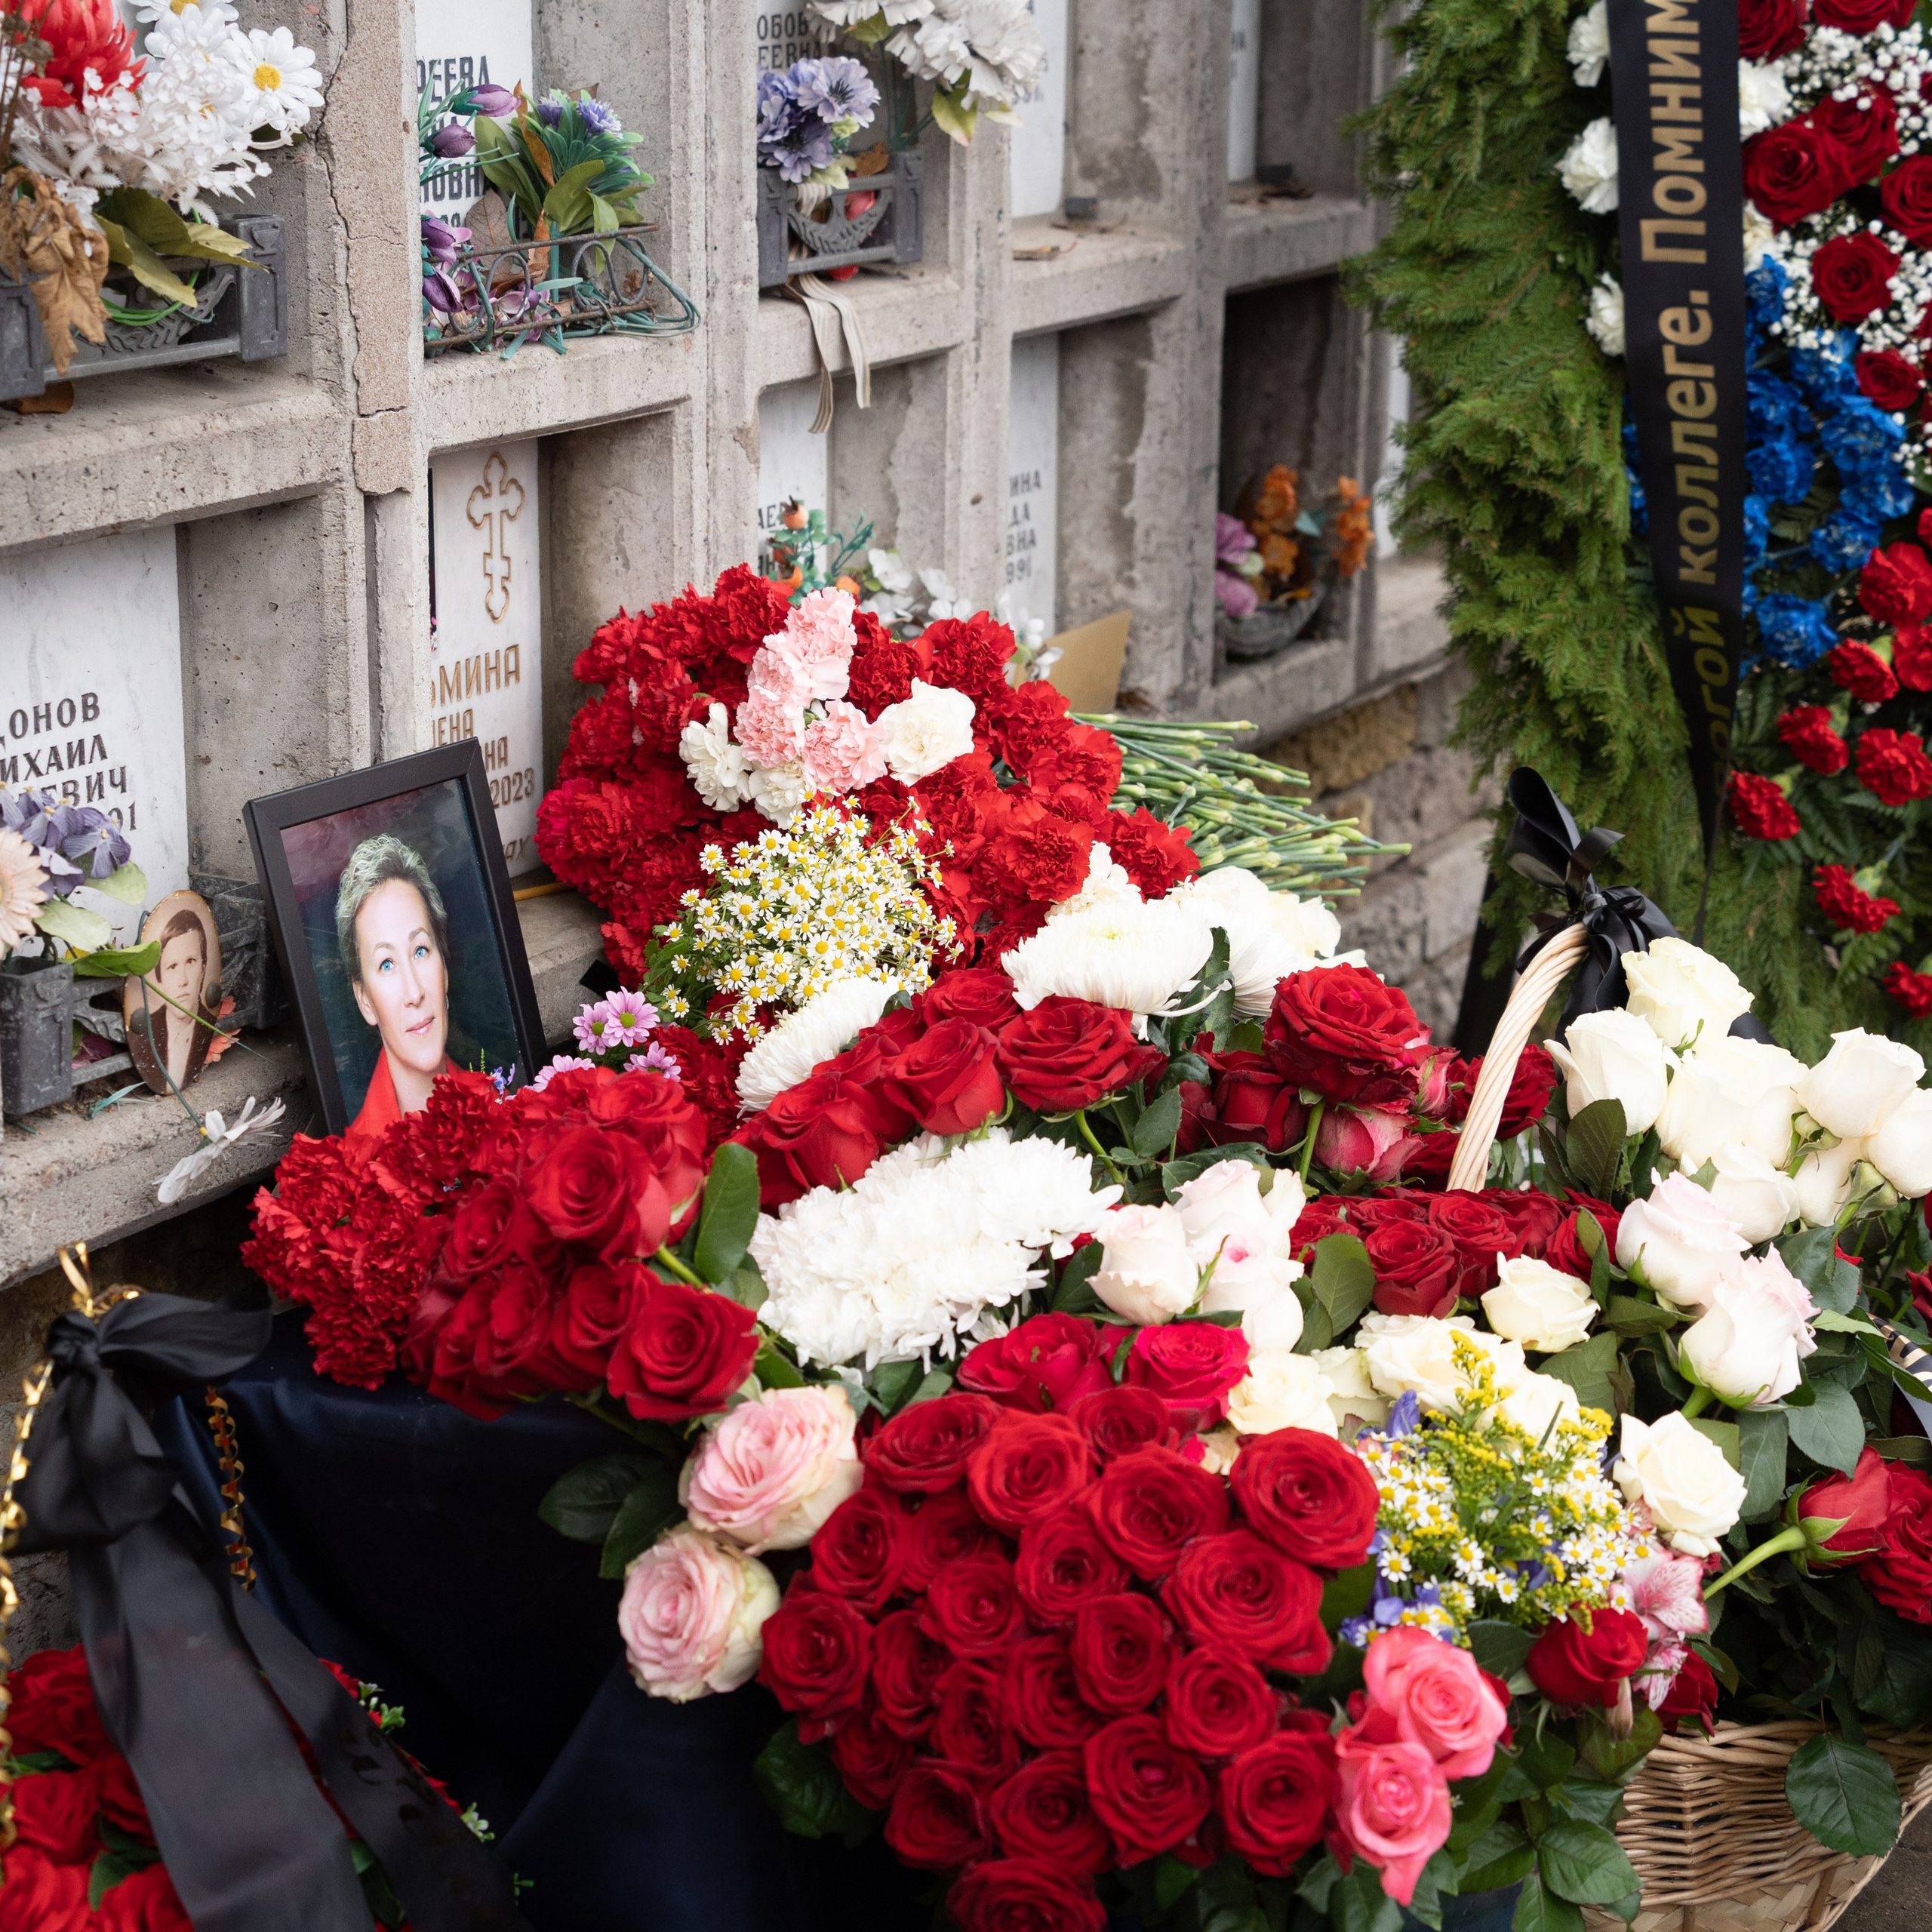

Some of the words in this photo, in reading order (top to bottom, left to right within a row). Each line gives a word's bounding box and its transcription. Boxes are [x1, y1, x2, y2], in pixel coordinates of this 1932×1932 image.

[1639, 0, 1708, 263] Помним
[1658, 290, 1720, 586] коллеге.
[0, 692, 100, 753] ОНОВ
[481, 736, 509, 773] НА
[490, 767, 535, 810] 2023
